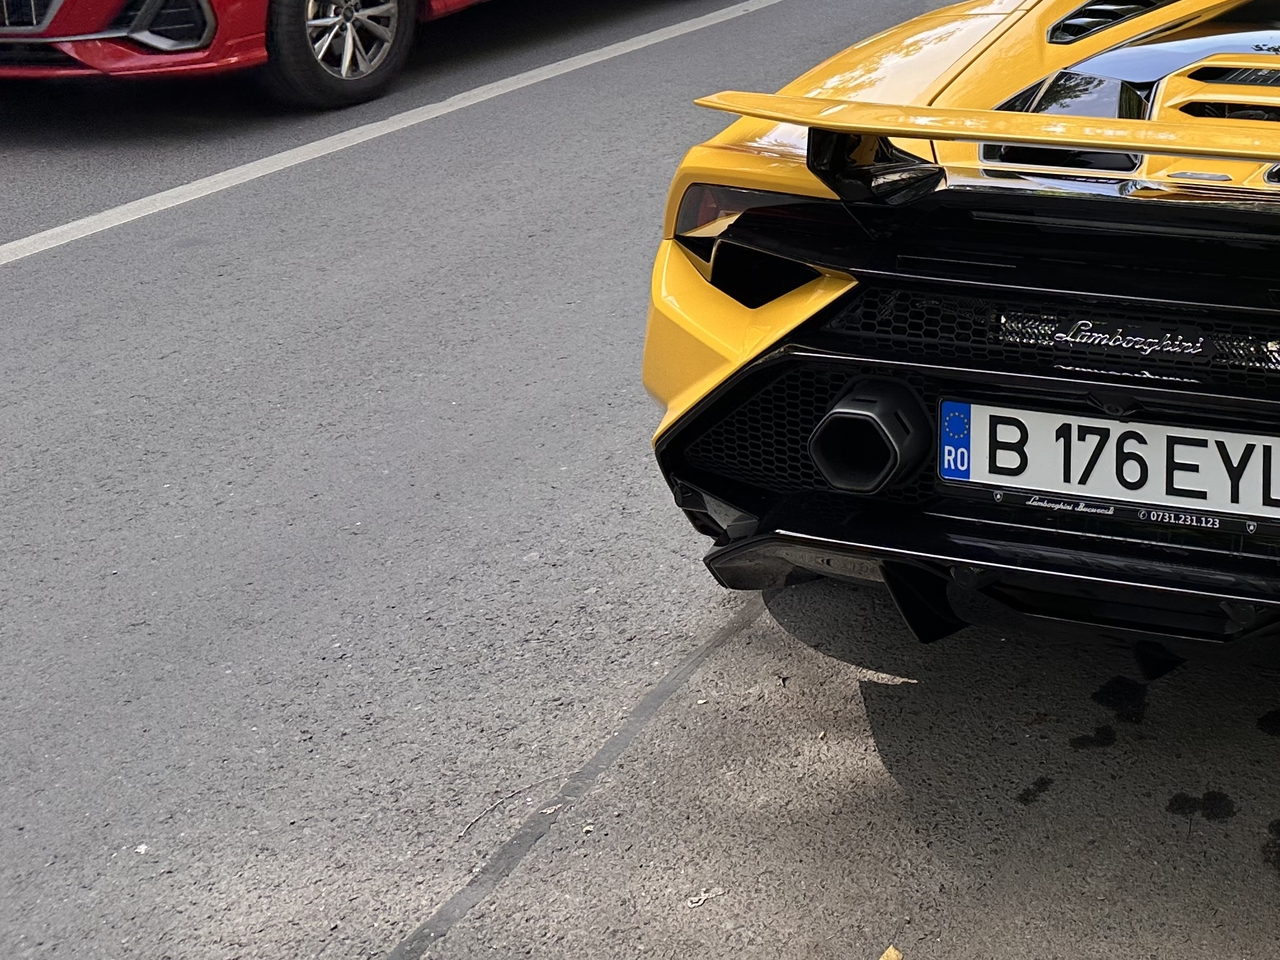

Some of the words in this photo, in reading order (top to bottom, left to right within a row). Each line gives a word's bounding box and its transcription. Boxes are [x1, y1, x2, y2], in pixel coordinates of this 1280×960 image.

[1054, 320, 1204, 355] Lamborghini
[944, 445, 968, 471] RO
[988, 414, 1029, 477] B
[1055, 422, 1149, 491] 176
[1025, 495, 1074, 511] Lamborghini
[1150, 511, 1220, 529] 0731.231.123
